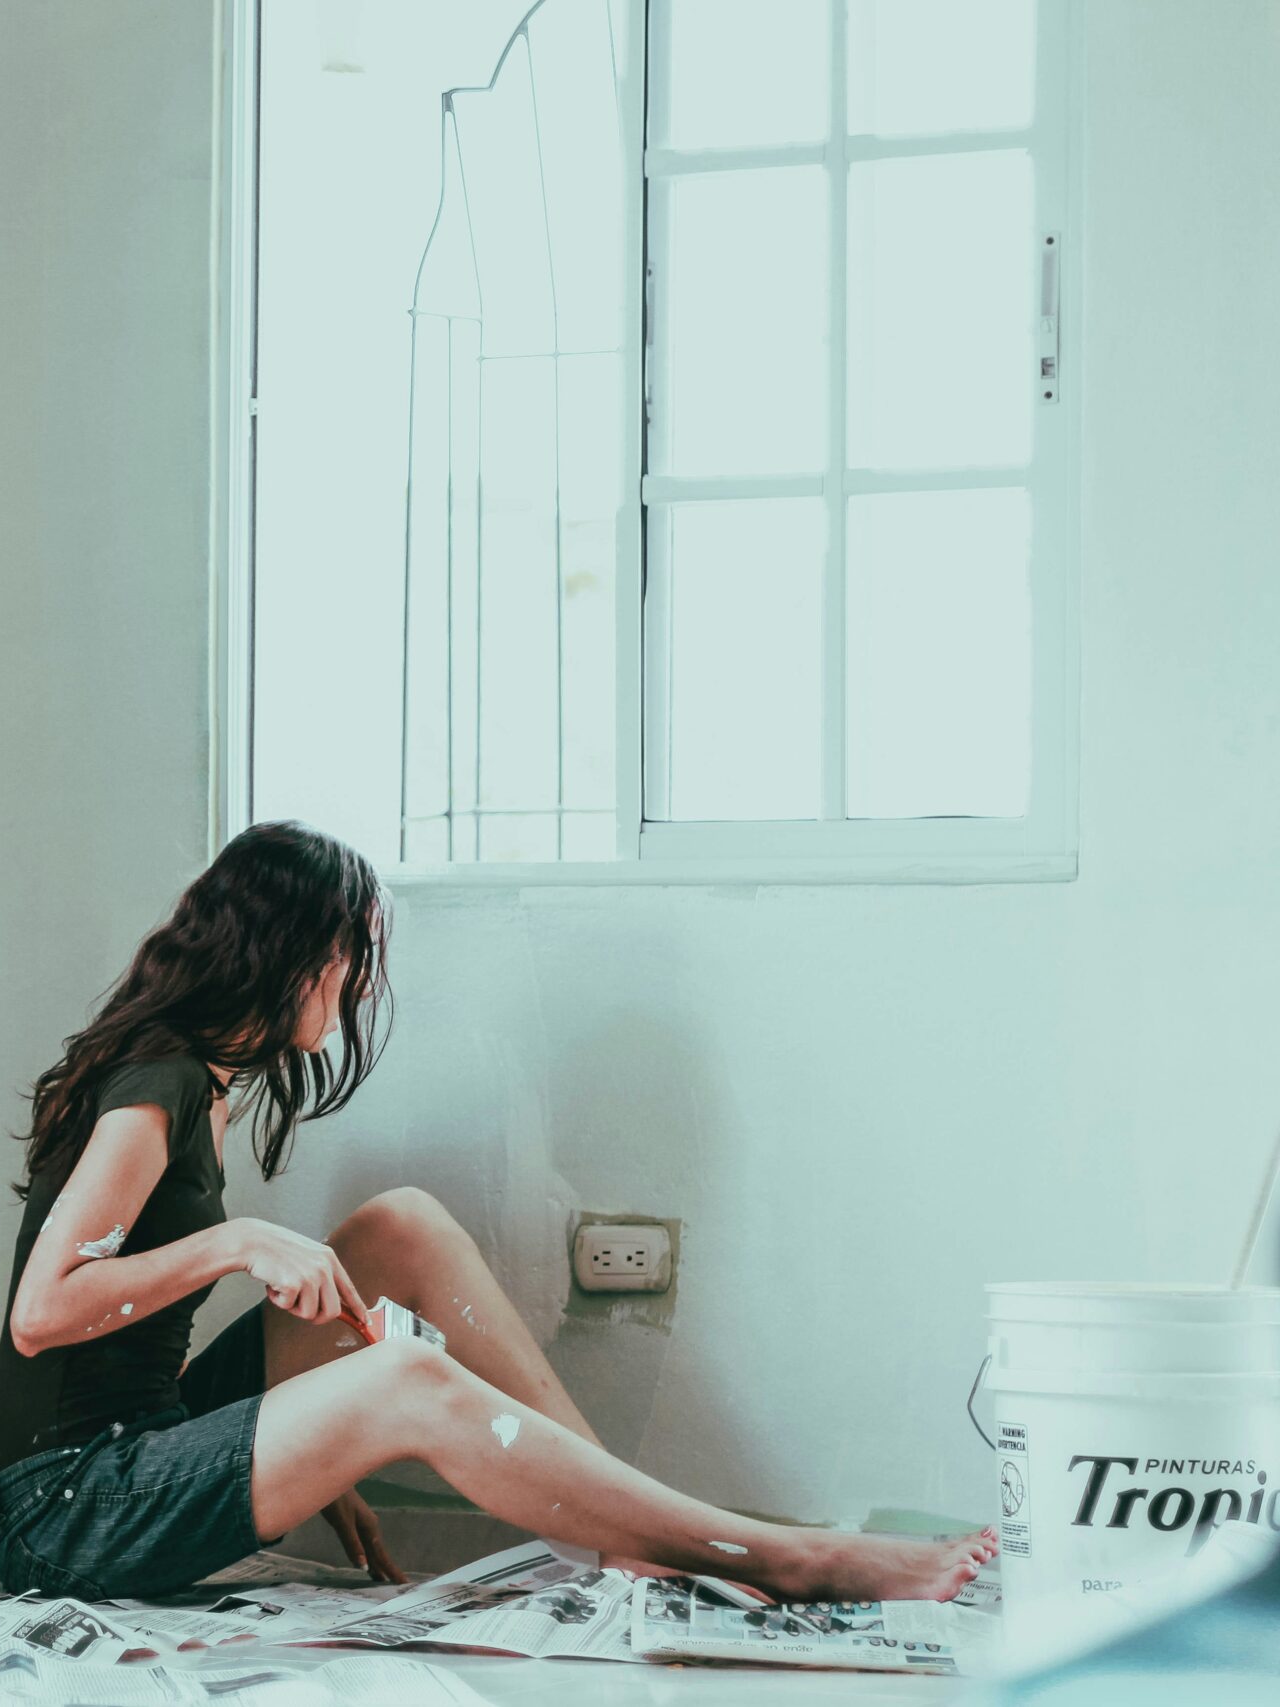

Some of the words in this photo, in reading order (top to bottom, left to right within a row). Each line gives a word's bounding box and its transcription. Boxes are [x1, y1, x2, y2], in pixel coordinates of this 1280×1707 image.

[998, 1439, 1026, 1451] DVERTENCIA
[1144, 1458, 1256, 1475] PINTURAS
[1081, 1578, 1123, 1594] para
